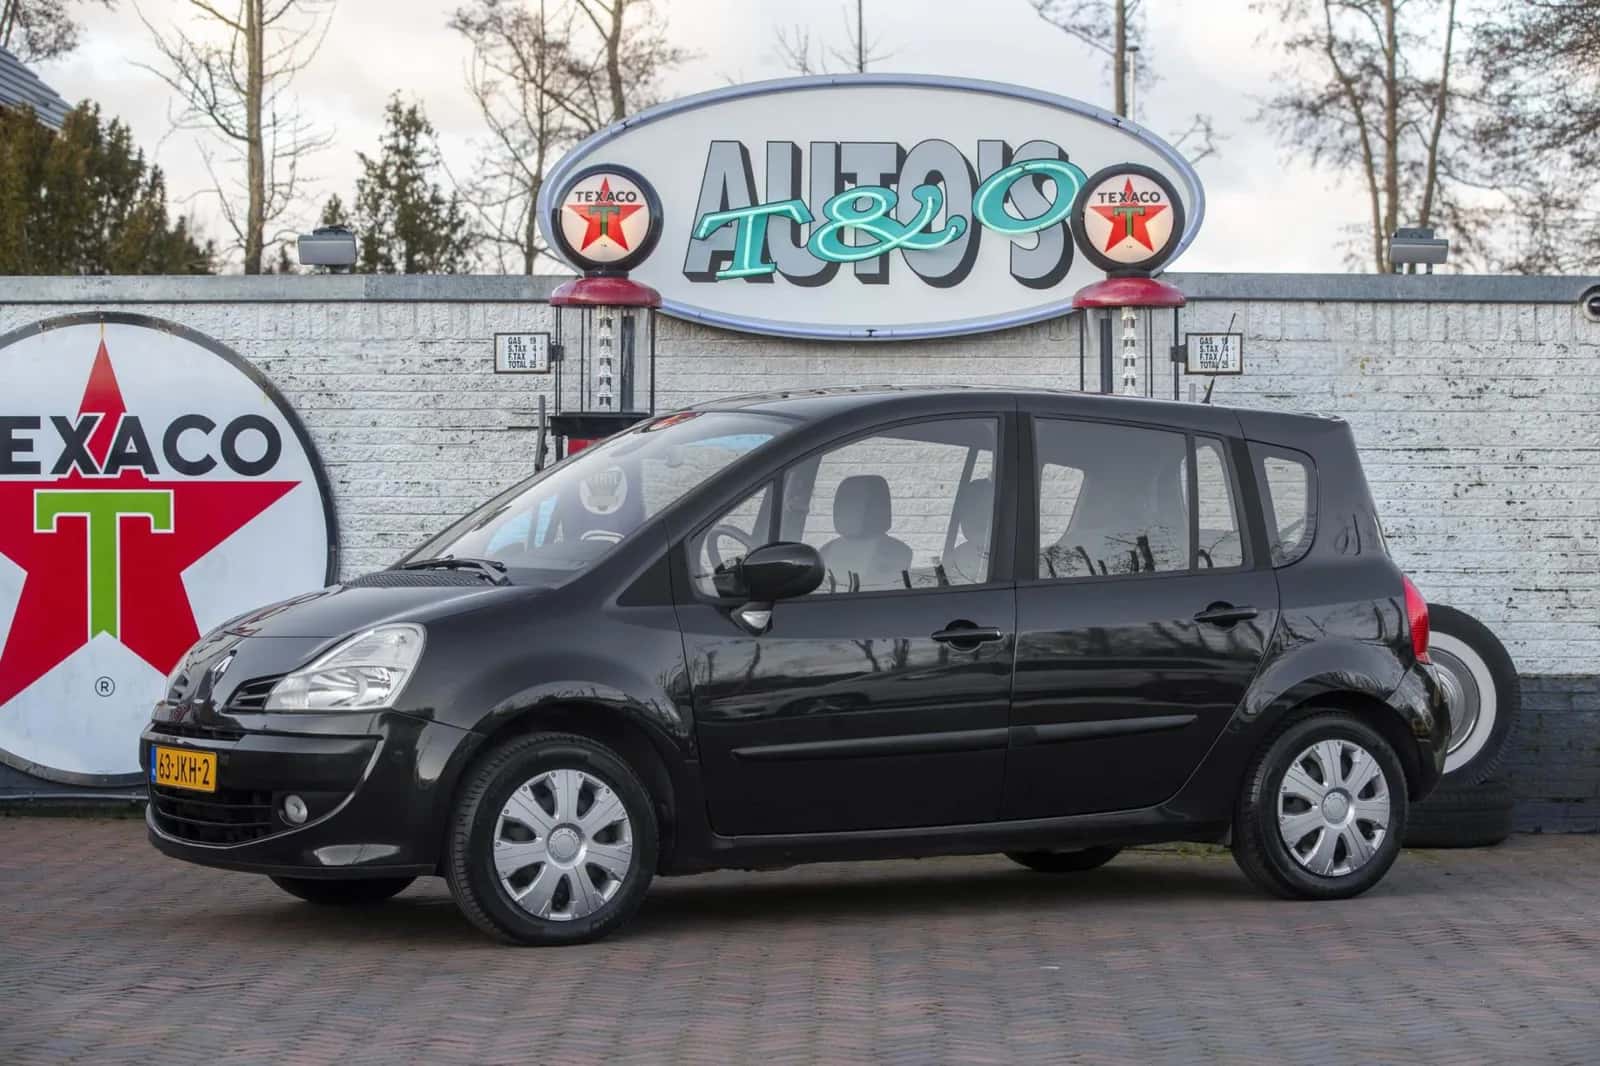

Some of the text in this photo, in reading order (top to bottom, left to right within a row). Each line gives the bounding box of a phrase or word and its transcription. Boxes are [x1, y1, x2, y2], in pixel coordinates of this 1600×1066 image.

[575, 191, 637, 203] TEXACO
[1097, 191, 1161, 204] TEXACO
[508, 336, 522, 344] GAS
[1200, 336, 1212, 344] GAS
[34, 490, 174, 641] T
[159, 753, 210, 785] 63-JKH-2
